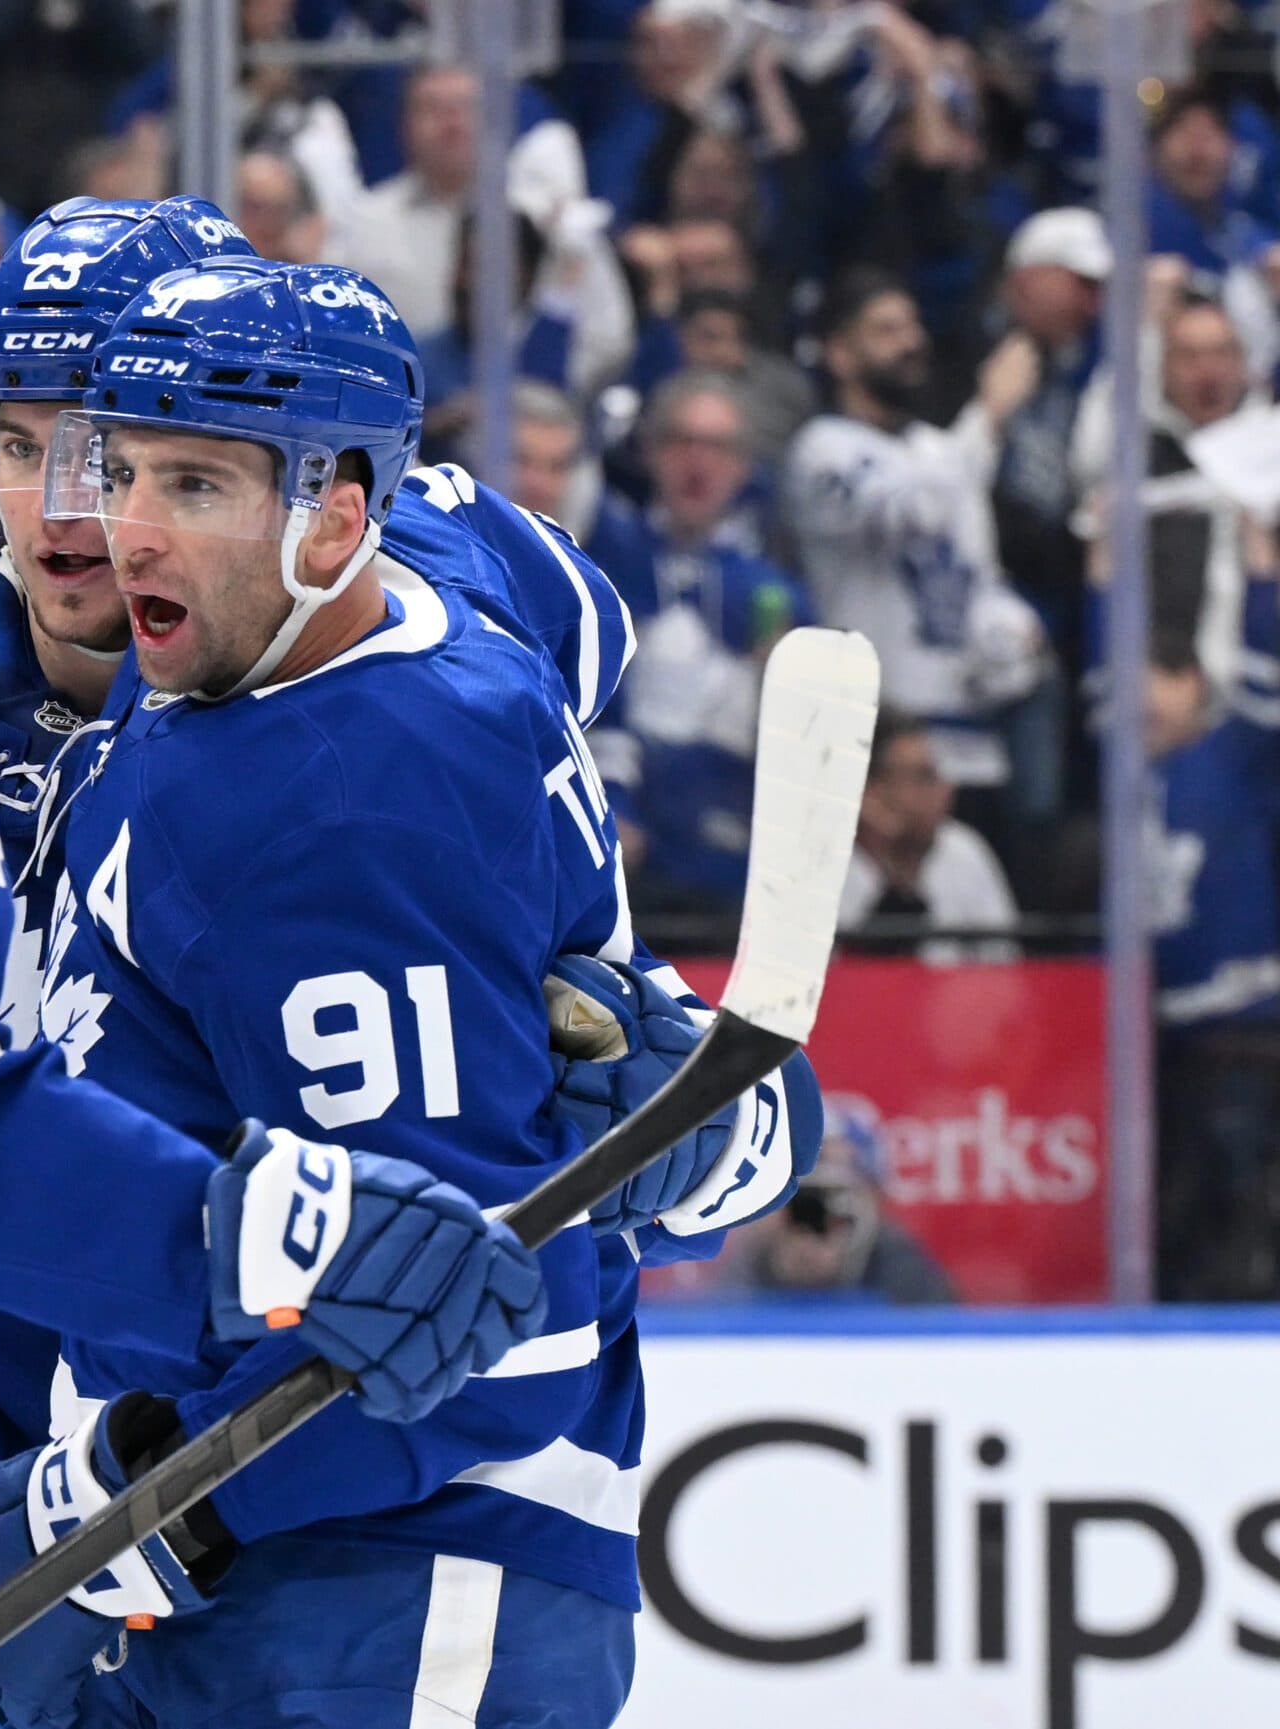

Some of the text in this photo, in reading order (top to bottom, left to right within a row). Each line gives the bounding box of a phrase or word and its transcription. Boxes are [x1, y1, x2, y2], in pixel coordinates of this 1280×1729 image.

[2, 332, 94, 350] CCM
[110, 355, 190, 378] CCM
[294, 497, 321, 510] CCM
[86, 817, 140, 969] A
[281, 963, 461, 1130] 91
[883, 1085, 1099, 1203] erks
